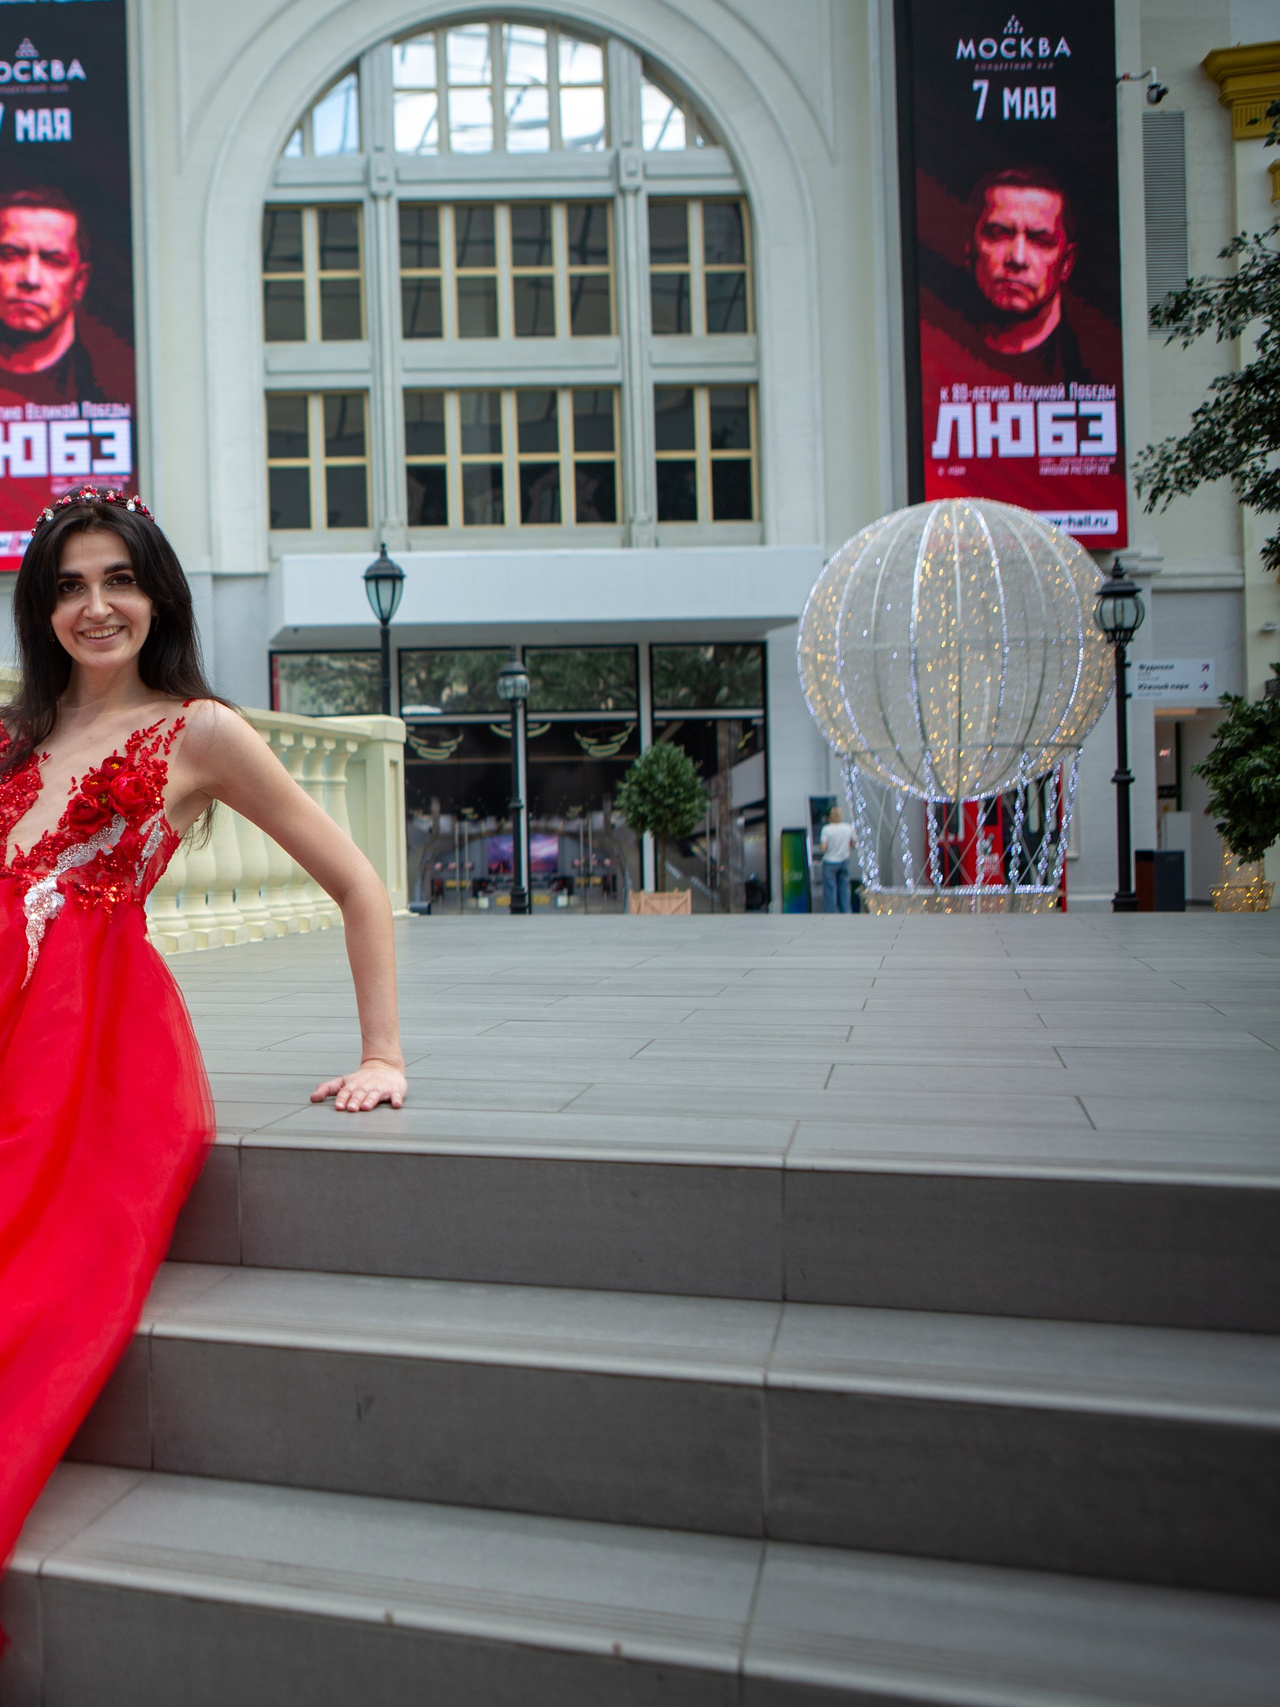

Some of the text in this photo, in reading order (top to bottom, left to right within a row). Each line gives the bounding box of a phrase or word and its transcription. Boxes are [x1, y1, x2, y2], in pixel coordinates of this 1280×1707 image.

[956, 36, 1072, 60] МОСКВА
[972, 79, 1057, 121] 7 МАЯ
[15, 107, 72, 143] МАЯ
[931, 401, 1118, 459] ЛЮБЭ
